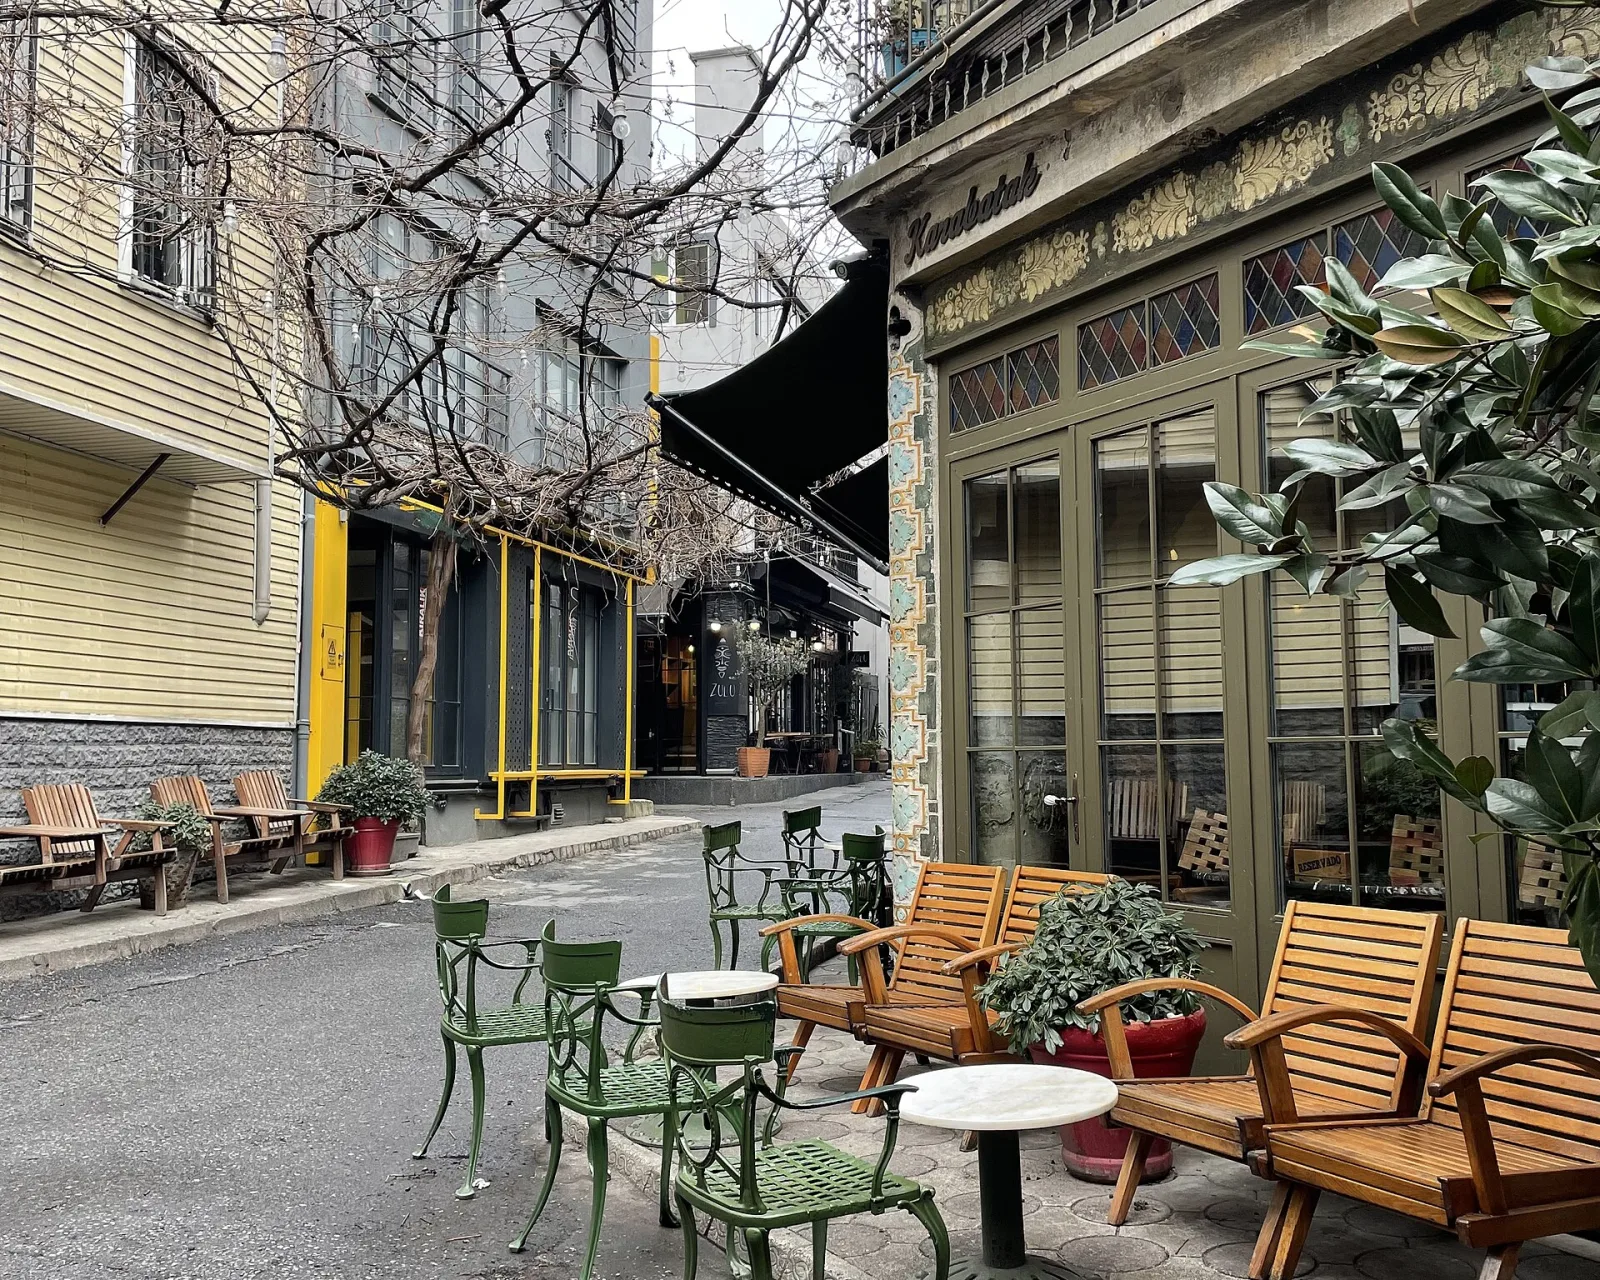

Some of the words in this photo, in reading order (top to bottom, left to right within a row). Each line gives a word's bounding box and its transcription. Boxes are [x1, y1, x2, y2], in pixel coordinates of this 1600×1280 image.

[904, 152, 1042, 266] Karabatak
[709, 682, 736, 698] ZULU
[1297, 855, 1342, 873] RESERVADO
